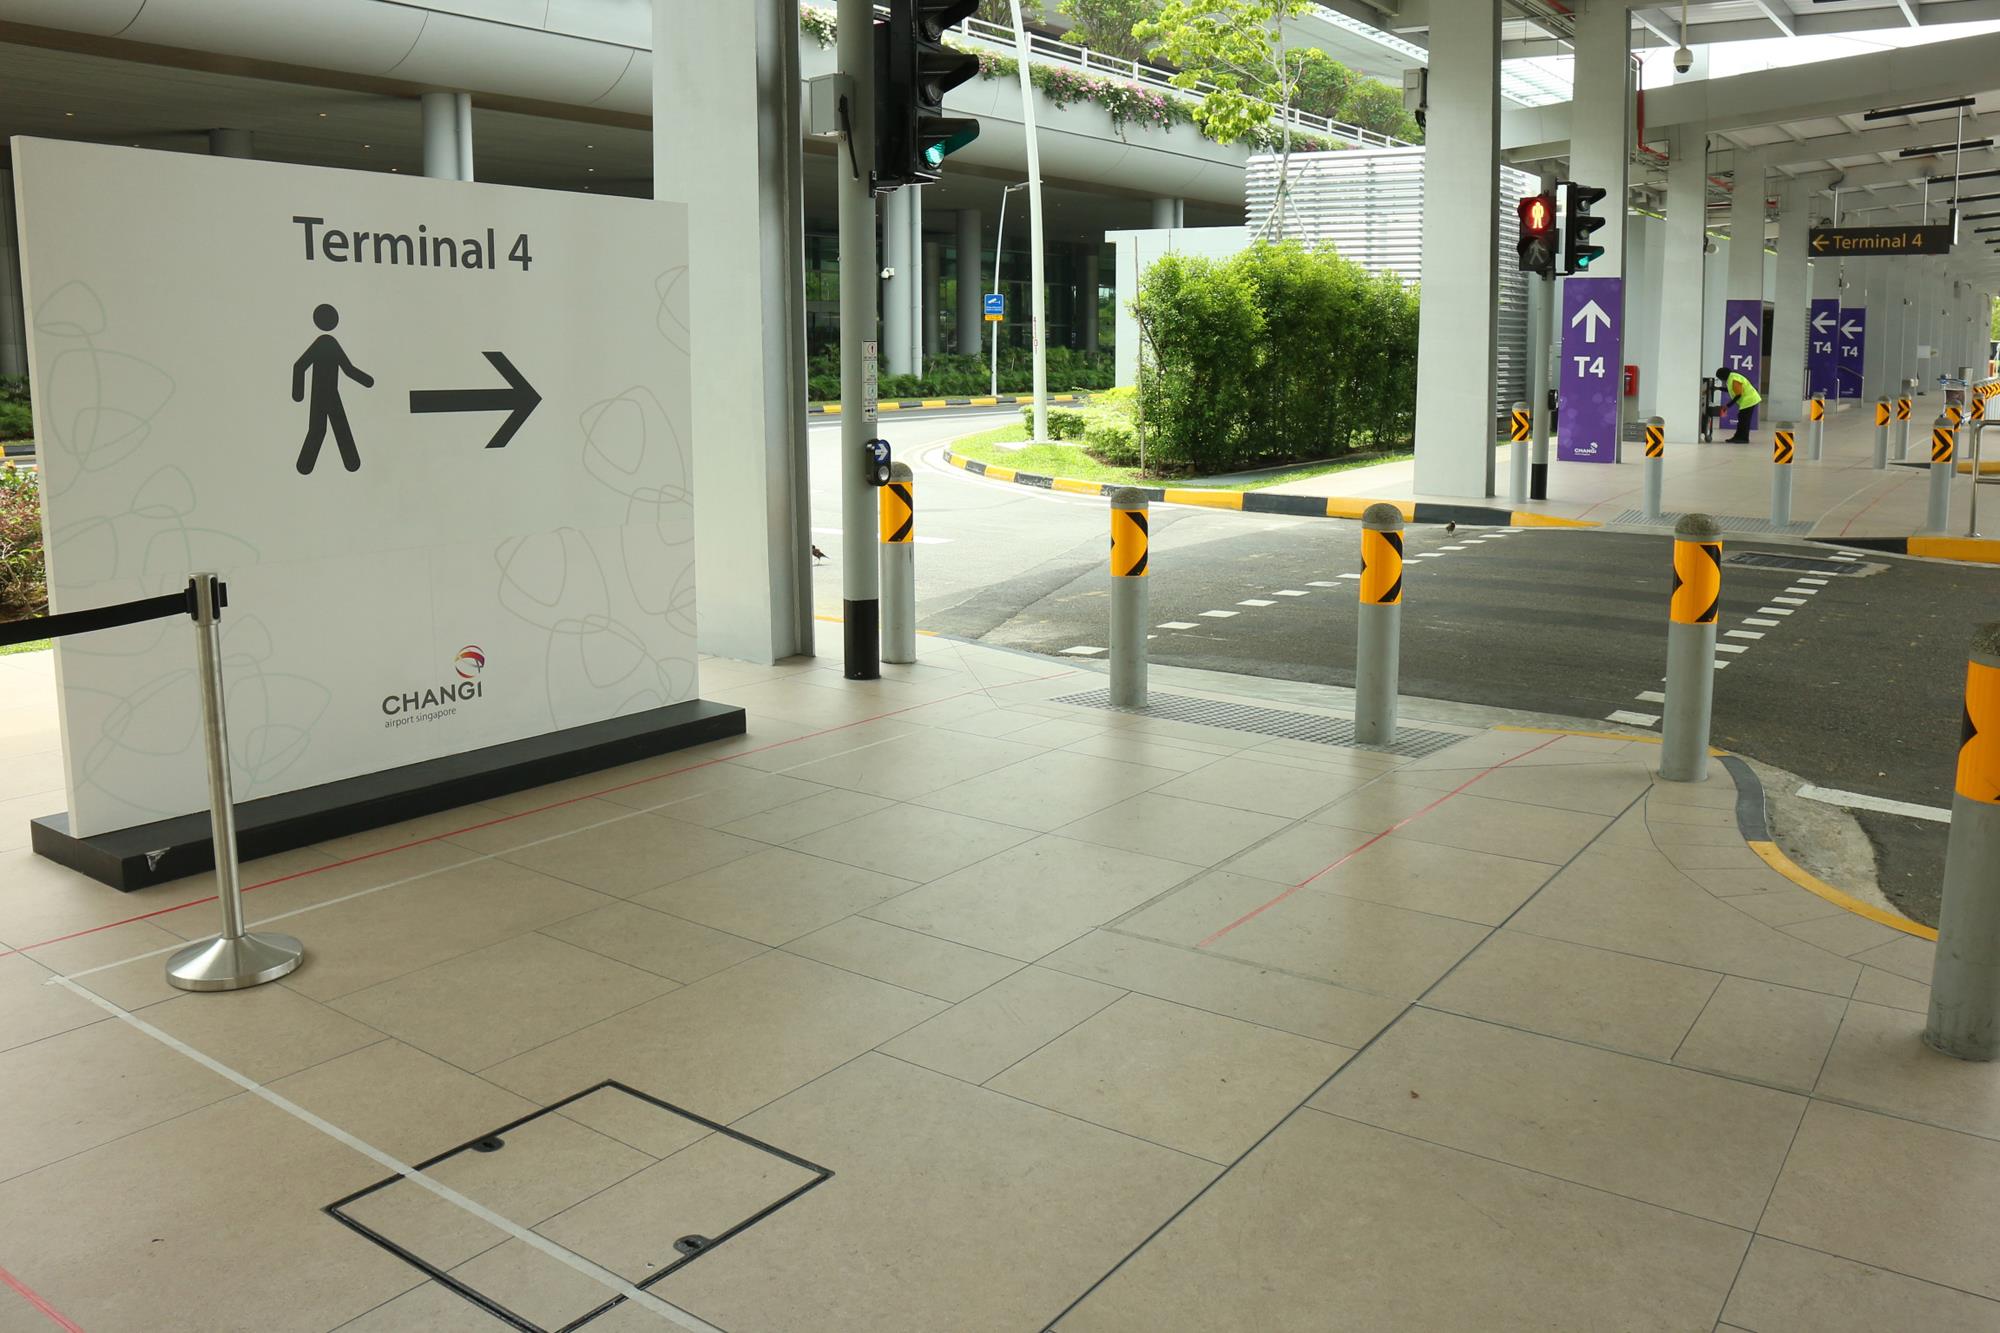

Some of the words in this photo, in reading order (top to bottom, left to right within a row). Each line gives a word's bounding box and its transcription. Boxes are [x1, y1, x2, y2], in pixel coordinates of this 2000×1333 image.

[293, 216, 495, 270] Terminal
[508, 234, 532, 271] 4
[1833, 233, 1906, 249] Terminal
[1911, 234, 1922, 247] 4
[1813, 341, 1832, 354] T4
[1842, 346, 1858, 357] T4
[1573, 356, 1605, 378] T4
[1730, 355, 1753, 370] T4
[382, 681, 482, 715] CHANGI
[385, 716, 414, 728] airport
[416, 707, 457, 722] singapore
